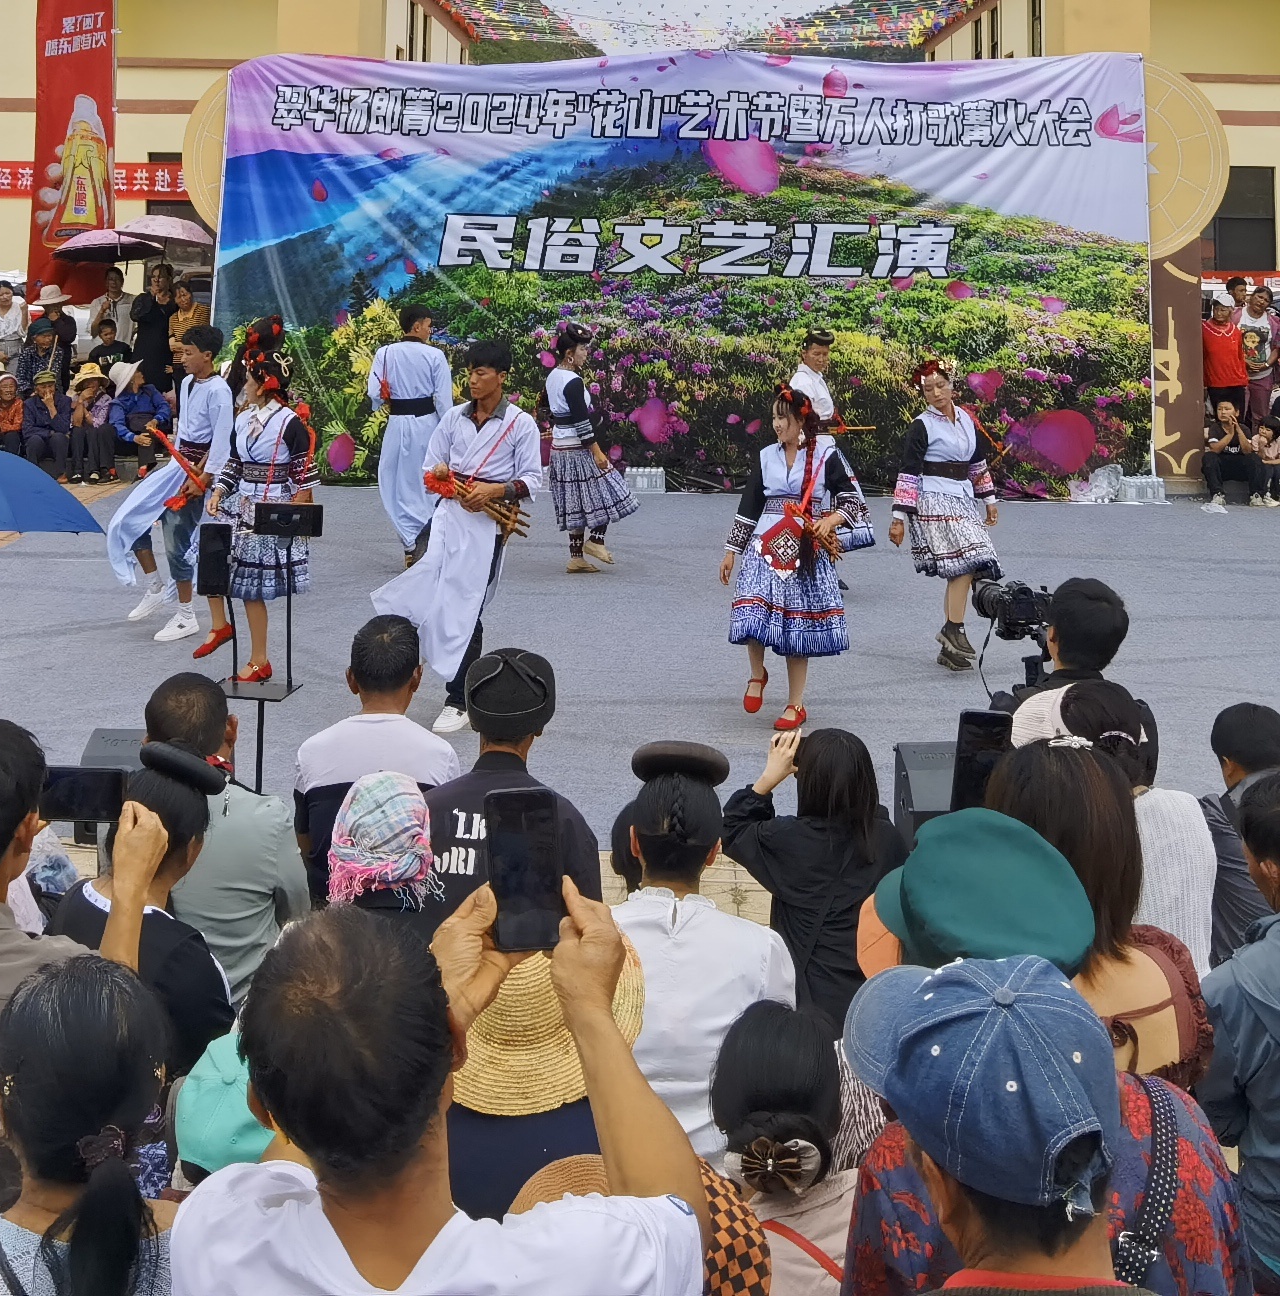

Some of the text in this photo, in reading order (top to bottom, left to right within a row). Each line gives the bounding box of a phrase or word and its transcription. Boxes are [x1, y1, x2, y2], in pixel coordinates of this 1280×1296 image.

[61, 11, 106, 34] 累了困了
[44, 31, 107, 57] 喝东鹏特饮
[438, 212, 956, 278] 民俗文艺汇演
